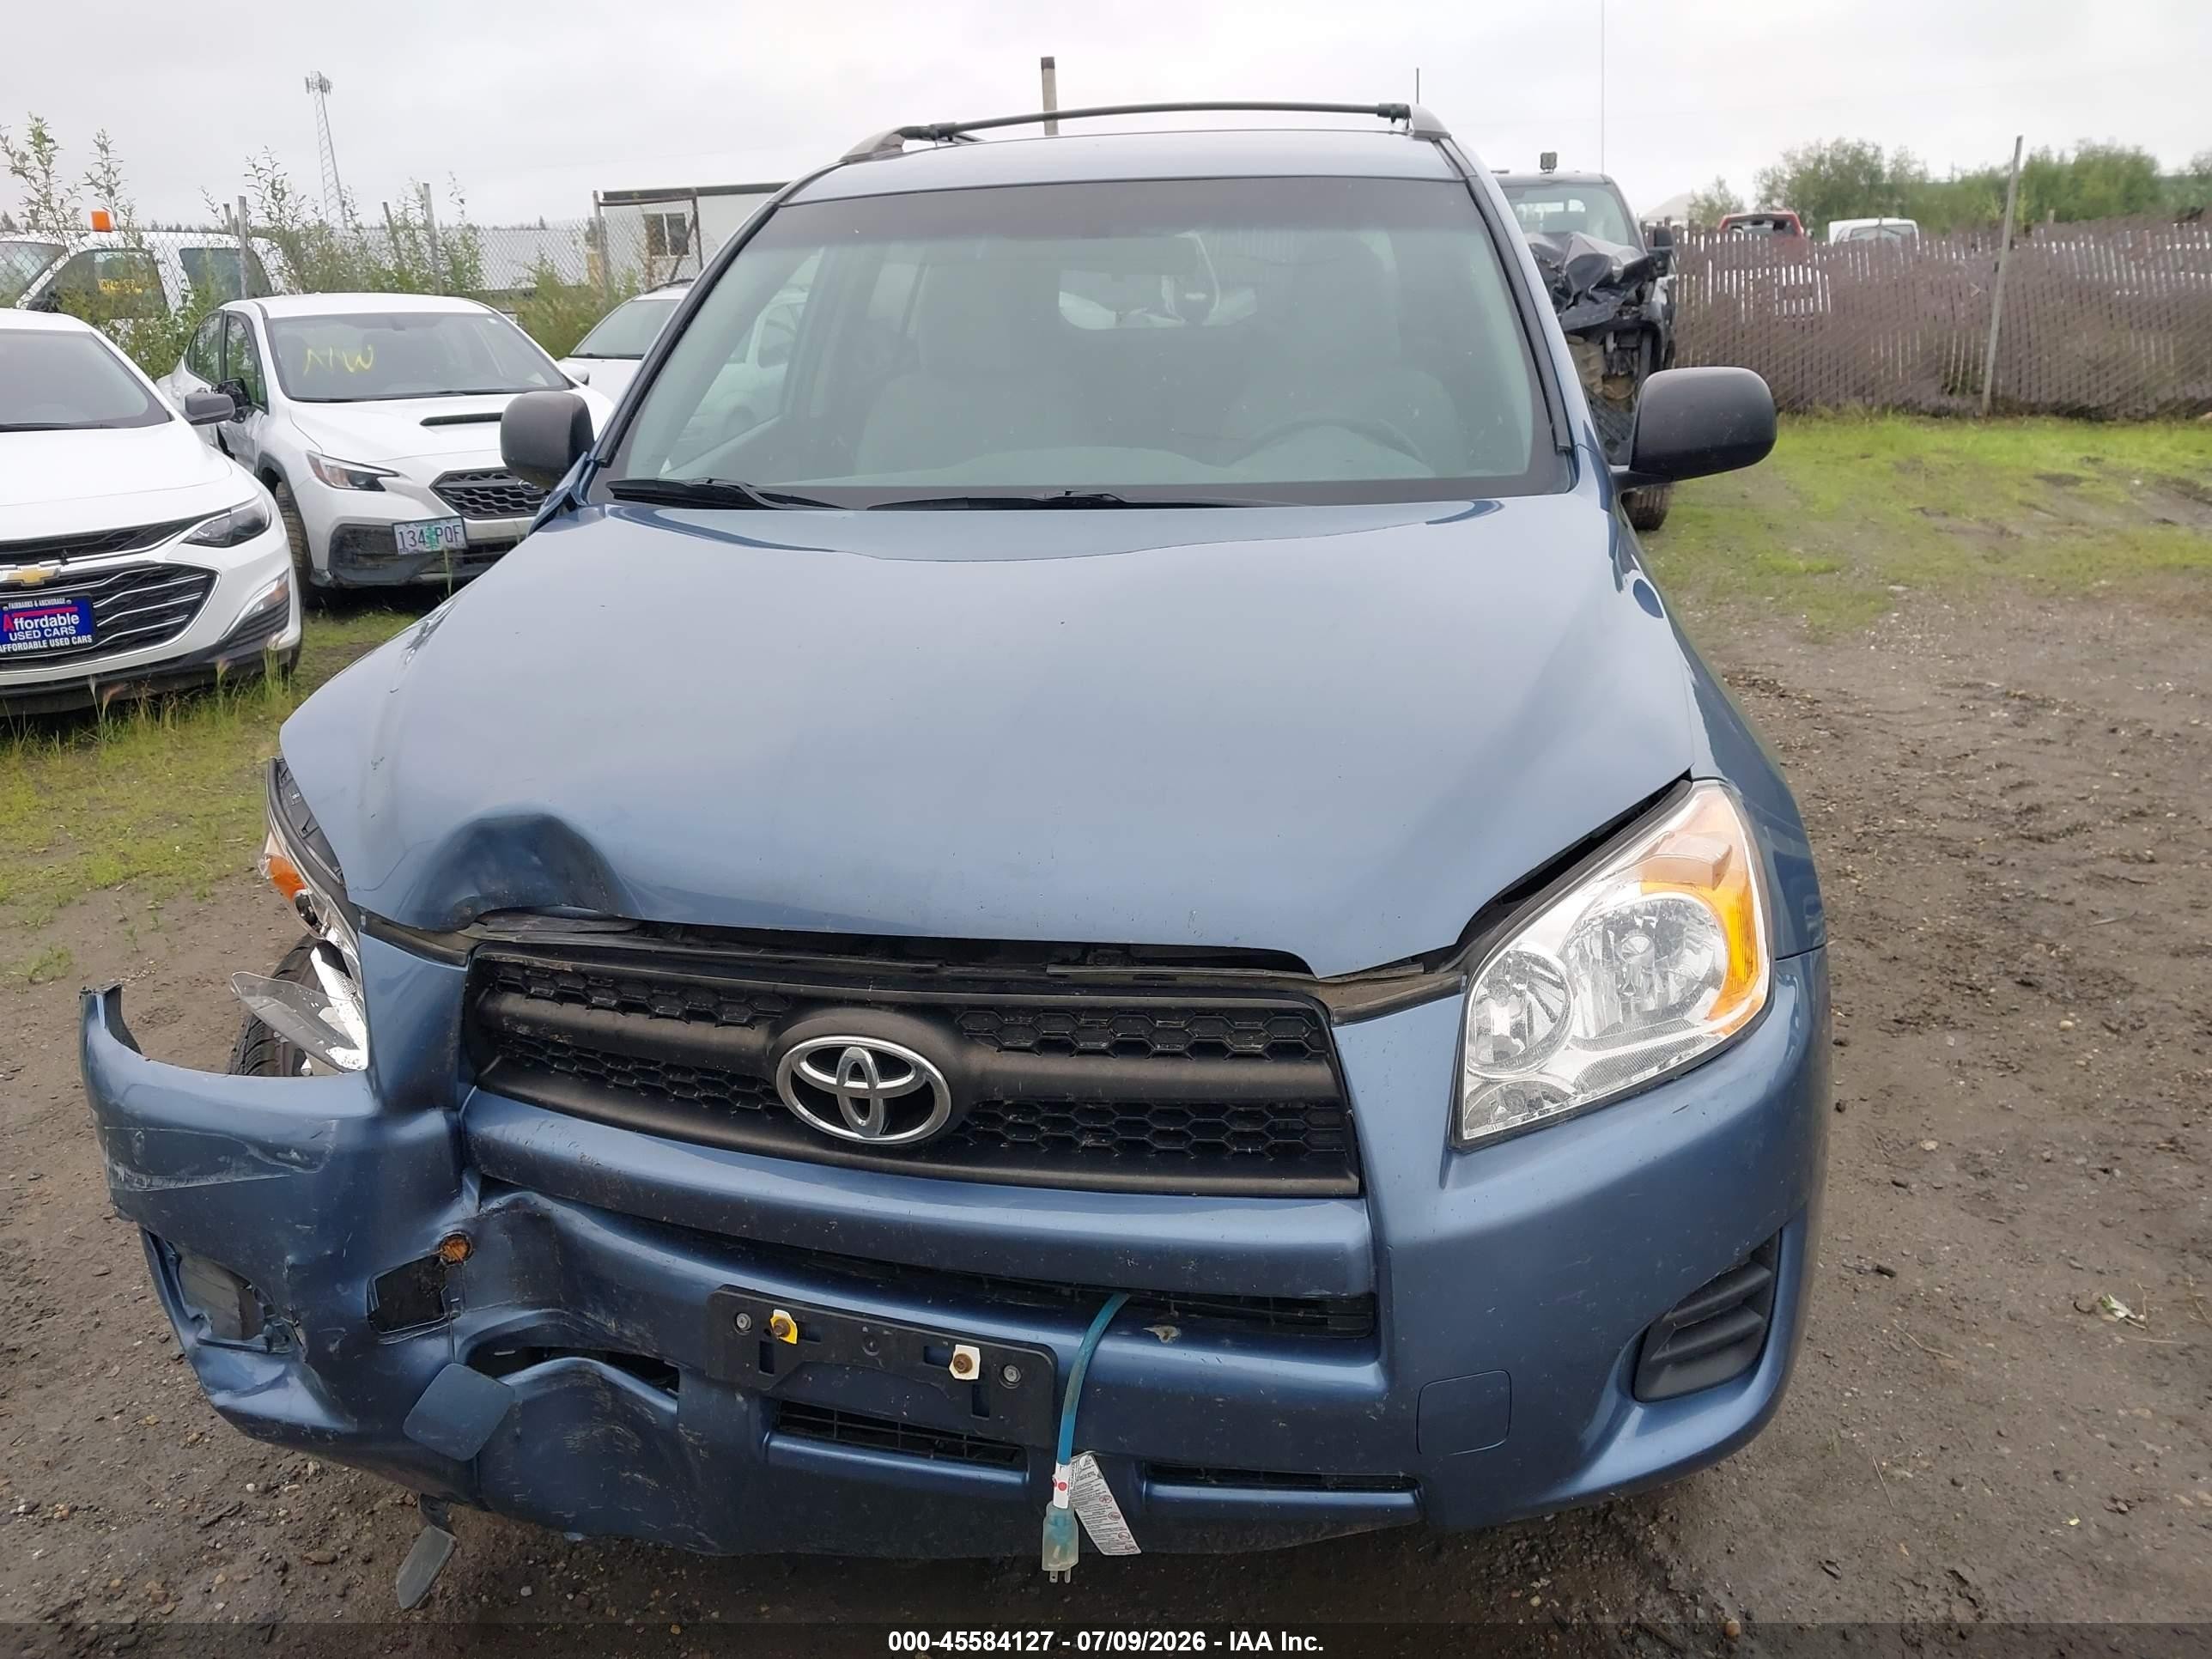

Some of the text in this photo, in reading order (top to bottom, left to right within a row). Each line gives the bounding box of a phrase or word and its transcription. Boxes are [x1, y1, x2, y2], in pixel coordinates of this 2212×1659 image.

[398, 525, 461, 550] 134 PQF
[3, 612, 80, 632] Affordable
[9, 626, 76, 641] USED CARS
[0, 635, 92, 653] AFFORDABLE USED CARS
